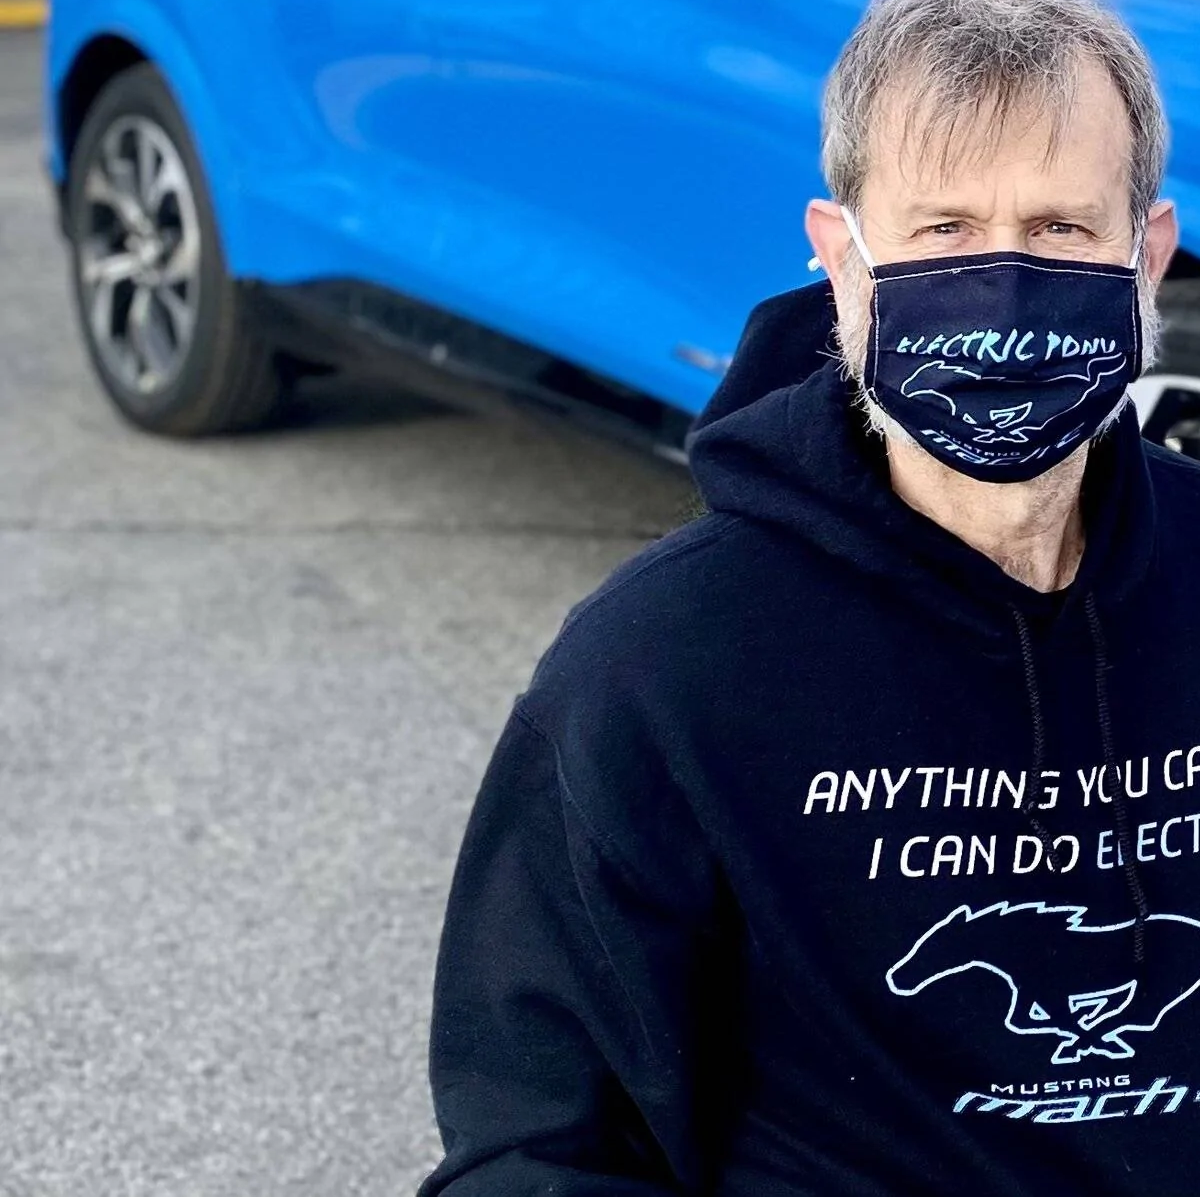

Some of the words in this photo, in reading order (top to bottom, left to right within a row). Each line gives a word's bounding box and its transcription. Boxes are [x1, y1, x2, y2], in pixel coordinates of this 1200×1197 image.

[896, 328, 1035, 363] ELECTRIC
[803, 766, 1061, 815] ANYTHING
[1076, 756, 1149, 807] YOU
[868, 837, 884, 880] I
[900, 834, 997, 878] CAN
[1012, 834, 1080, 874] DO
[990, 1074, 1131, 1095] MUSTANG
